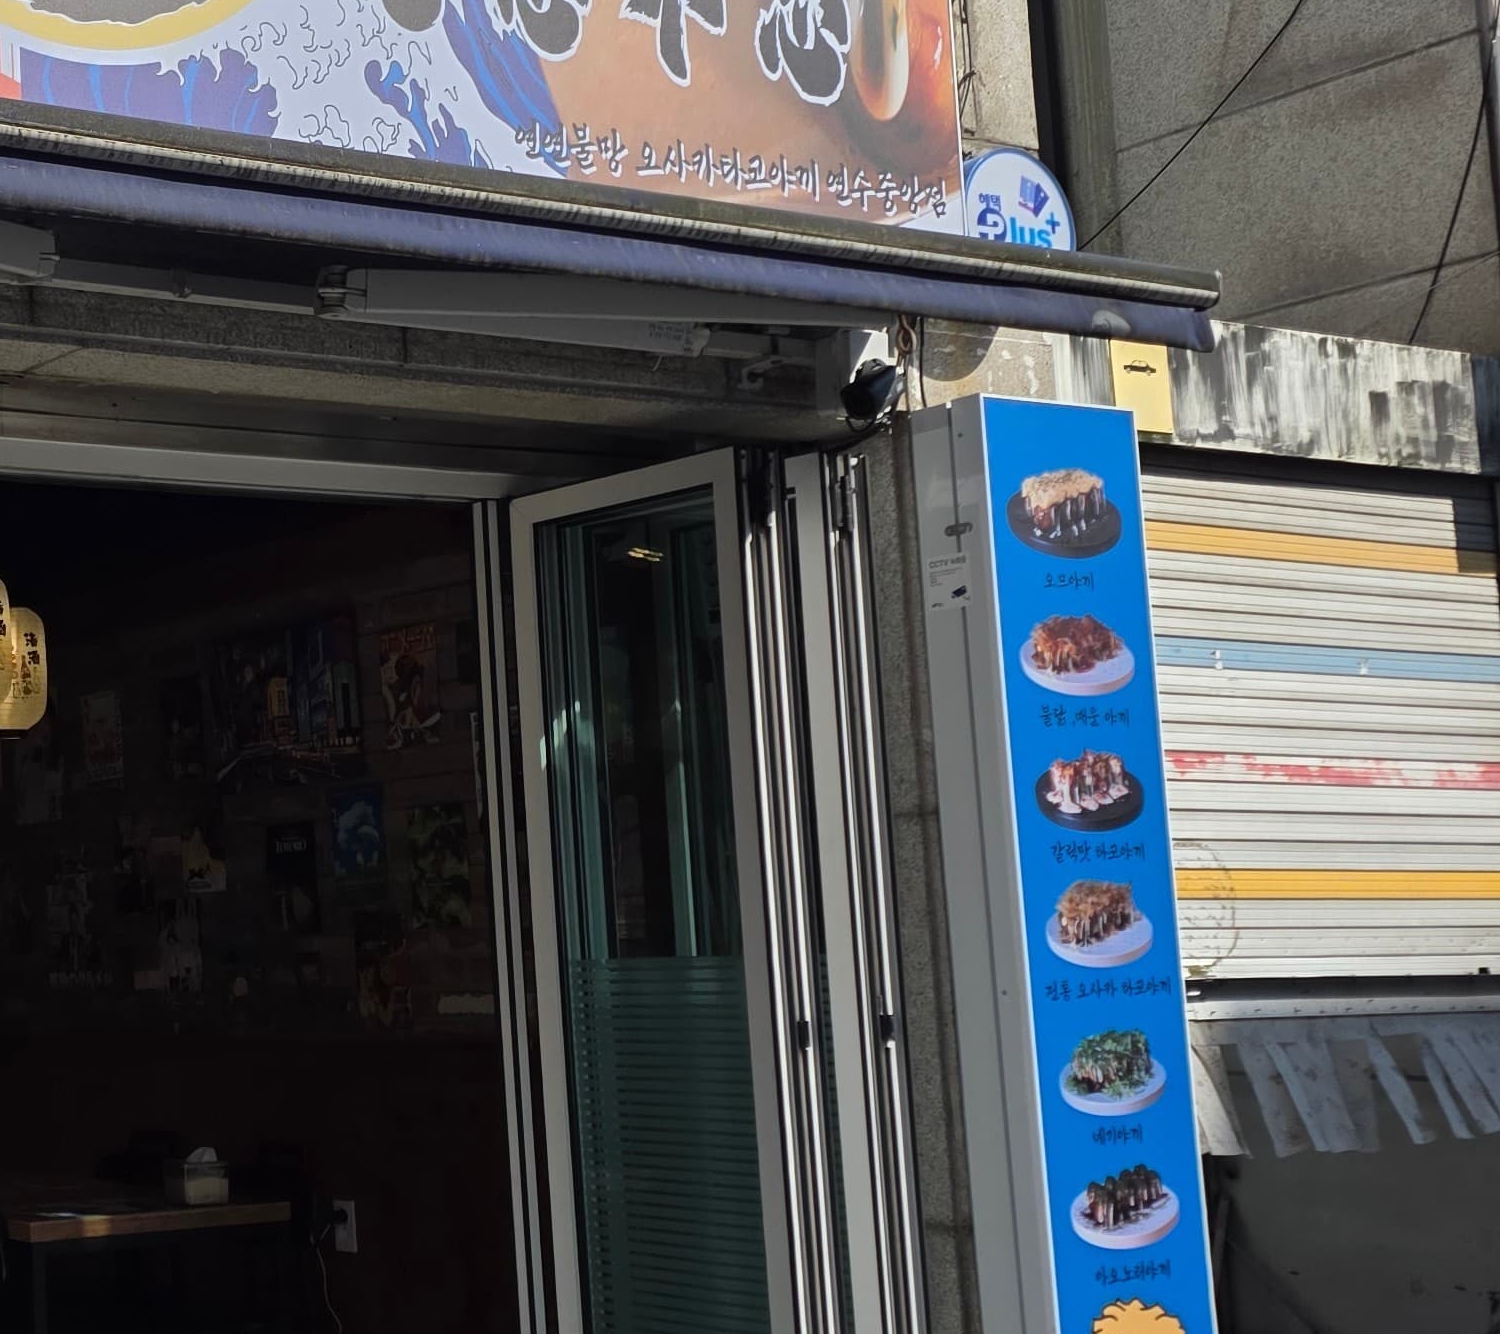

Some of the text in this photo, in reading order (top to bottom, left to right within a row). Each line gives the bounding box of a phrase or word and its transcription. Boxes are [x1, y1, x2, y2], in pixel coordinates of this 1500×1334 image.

[514, 119, 947, 219] 연연불망 오사카타코야끼 연수중앙점
